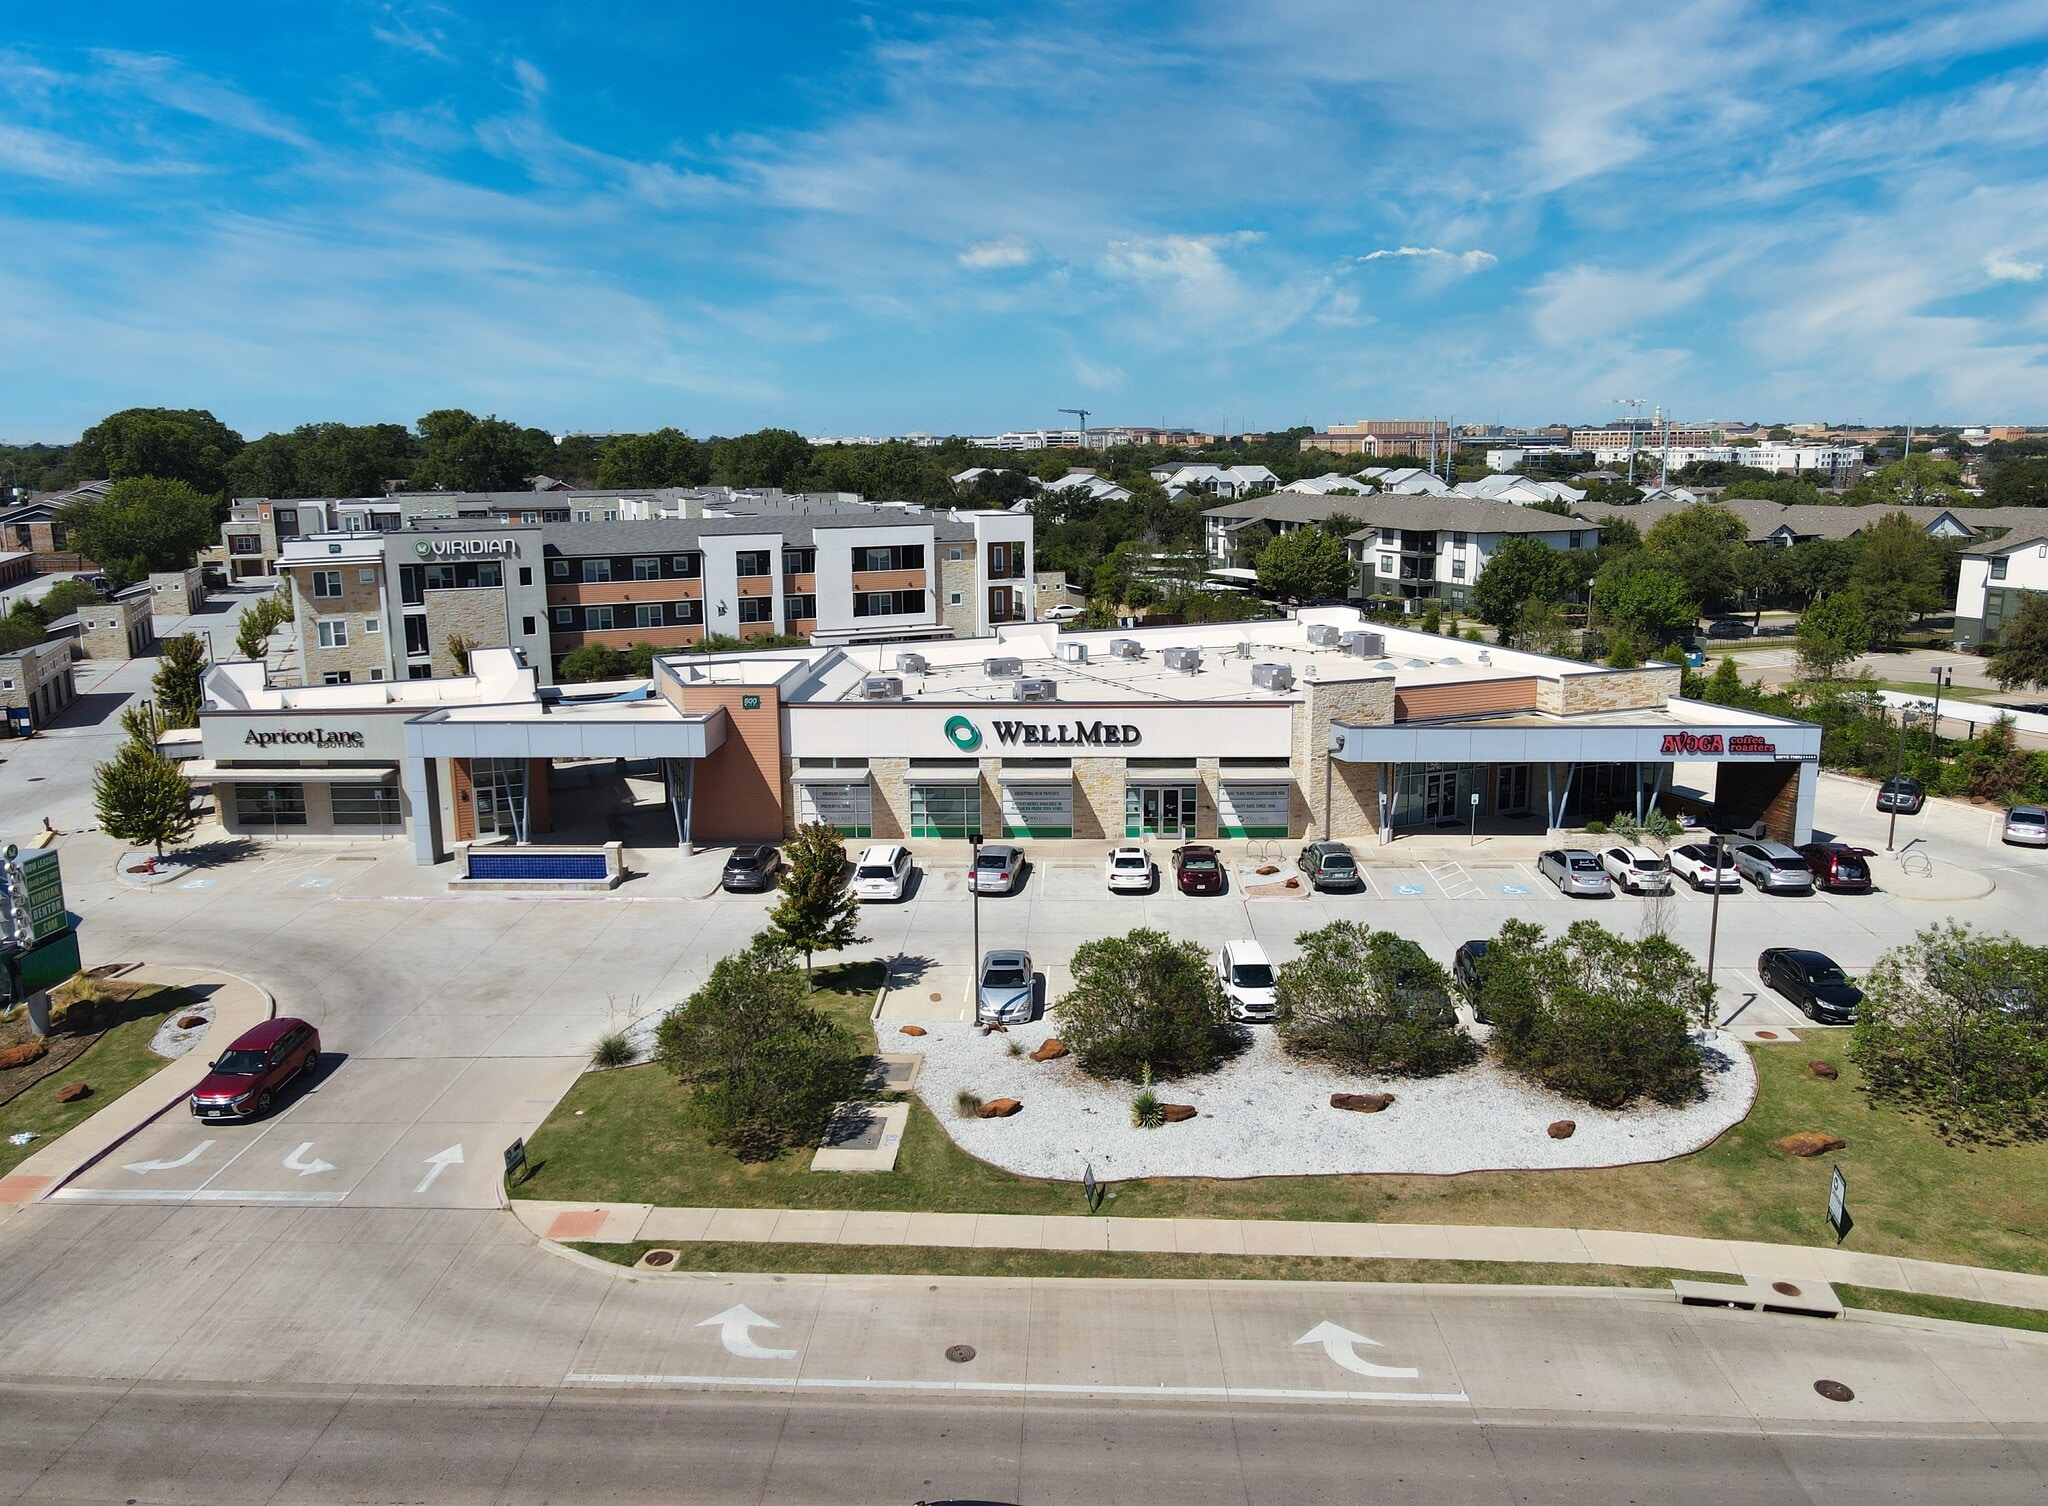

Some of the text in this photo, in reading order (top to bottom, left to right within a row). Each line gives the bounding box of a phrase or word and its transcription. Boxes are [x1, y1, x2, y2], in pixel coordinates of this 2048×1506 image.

[432, 538, 516, 554] VIRIDIAN
[1661, 731, 1724, 754] AVOCA
[1730, 736, 1764, 744] coffee
[1730, 743, 1776, 752] roasters
[37, 855, 56, 868] LEASING
[31, 885, 59, 904] VIRIDIAN
[33, 900, 61, 919] DENTON
[41, 919, 58, 934] .COM
